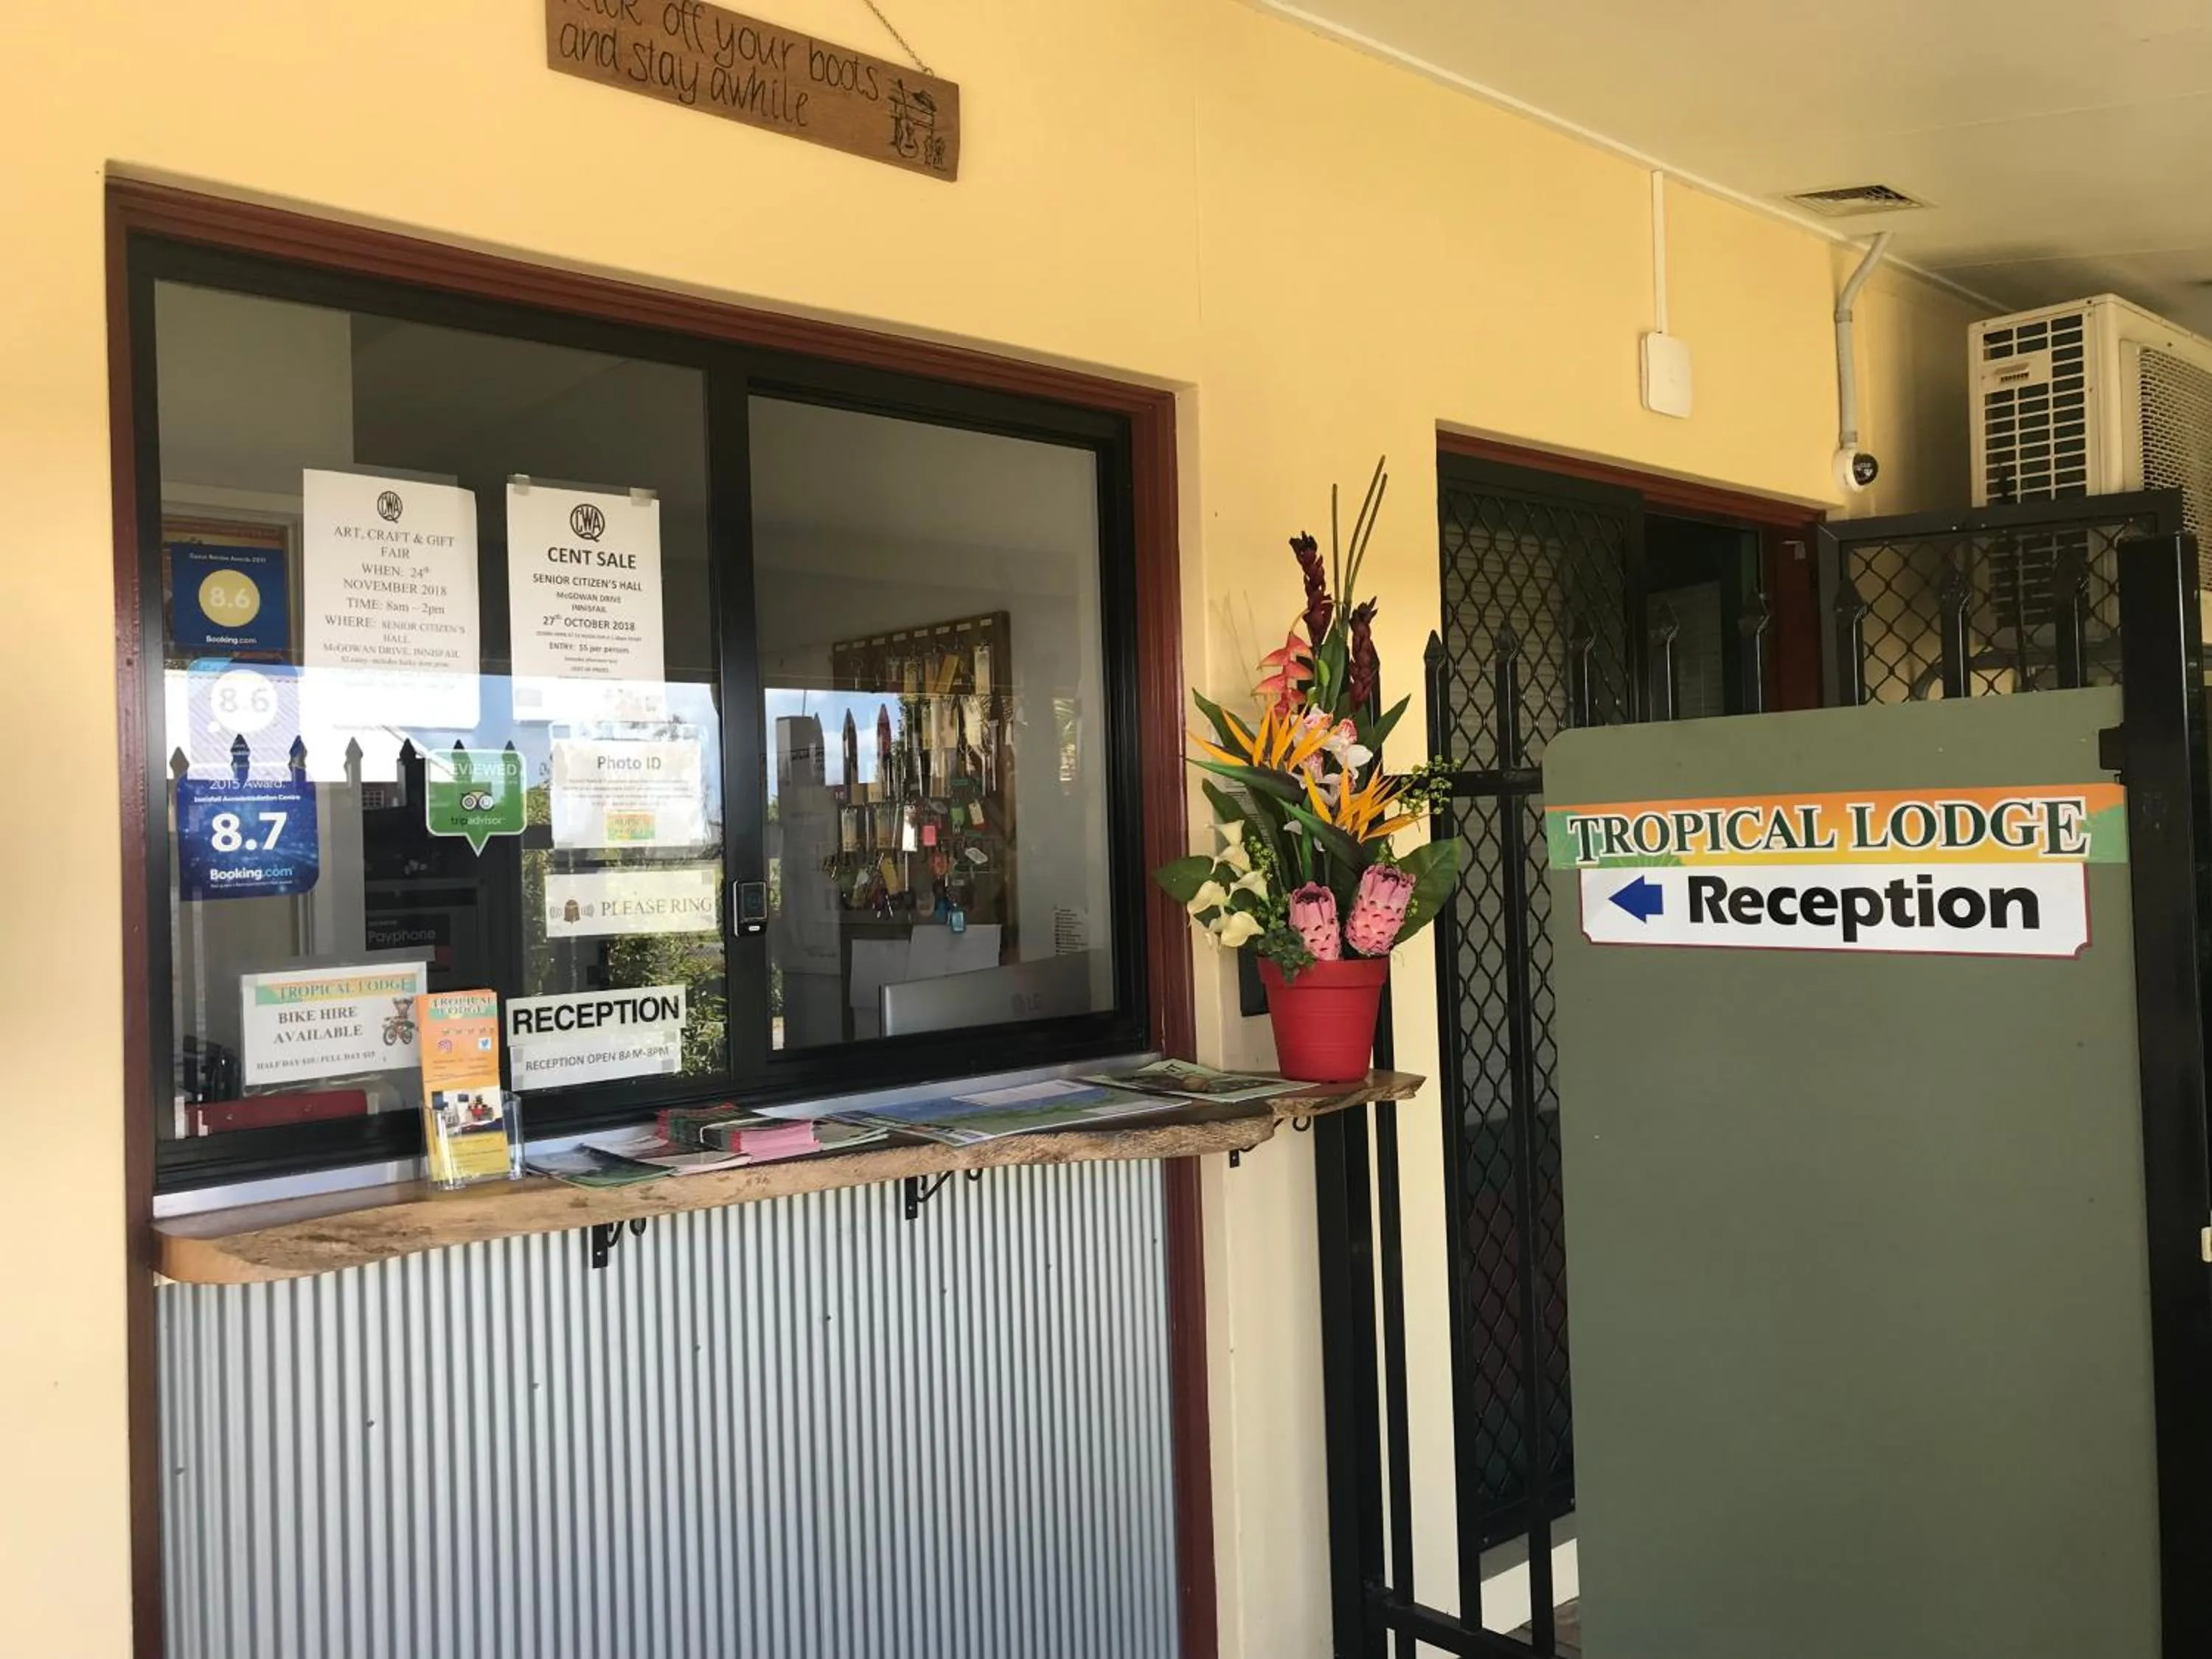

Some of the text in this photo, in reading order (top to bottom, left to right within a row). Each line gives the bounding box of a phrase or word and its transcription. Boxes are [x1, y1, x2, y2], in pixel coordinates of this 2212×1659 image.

[563, 0, 879, 101] ick off your boots
[560, 23, 809, 126] and stay awhile
[367, 528, 411, 543] CRAFT
[413, 533, 424, 544] &
[426, 535, 455, 547] GIFT
[380, 546, 411, 559] FAIR
[548, 546, 637, 570] CENT SALE
[343, 578, 448, 597] NOVEMBER 2018
[533, 573, 571, 587] SENIOR
[619, 580, 643, 591] HALL
[209, 587, 251, 609] 8.6
[346, 597, 383, 611] TIME:
[386, 602, 410, 613] 8am
[420, 603, 445, 616] 2pm
[557, 591, 622, 604] McGOWAN DRIVE
[564, 616, 610, 630] OCTOBER
[613, 620, 636, 632] 2018
[206, 635, 257, 645] Booking.com
[448, 762, 518, 777] EVIEWED
[597, 755, 662, 770] Photo ID
[209, 778, 240, 790] 2015
[211, 812, 288, 852] 8.7
[1569, 796, 2089, 864] TROPICAL LODGE
[210, 867, 293, 881] Booking.com
[601, 897, 712, 917] PLEASE RING
[1688, 874, 2041, 943] Reception
[368, 928, 437, 945] Payphone
[279, 978, 410, 1000] TROPICAL LODGE
[278, 1006, 358, 1024] BIKE HIRE
[512, 995, 680, 1035] RECEPTION
[274, 1024, 363, 1044] AVAILABLE
[526, 1055, 585, 1071] RECEPTION
[587, 1051, 616, 1065] OPEN
